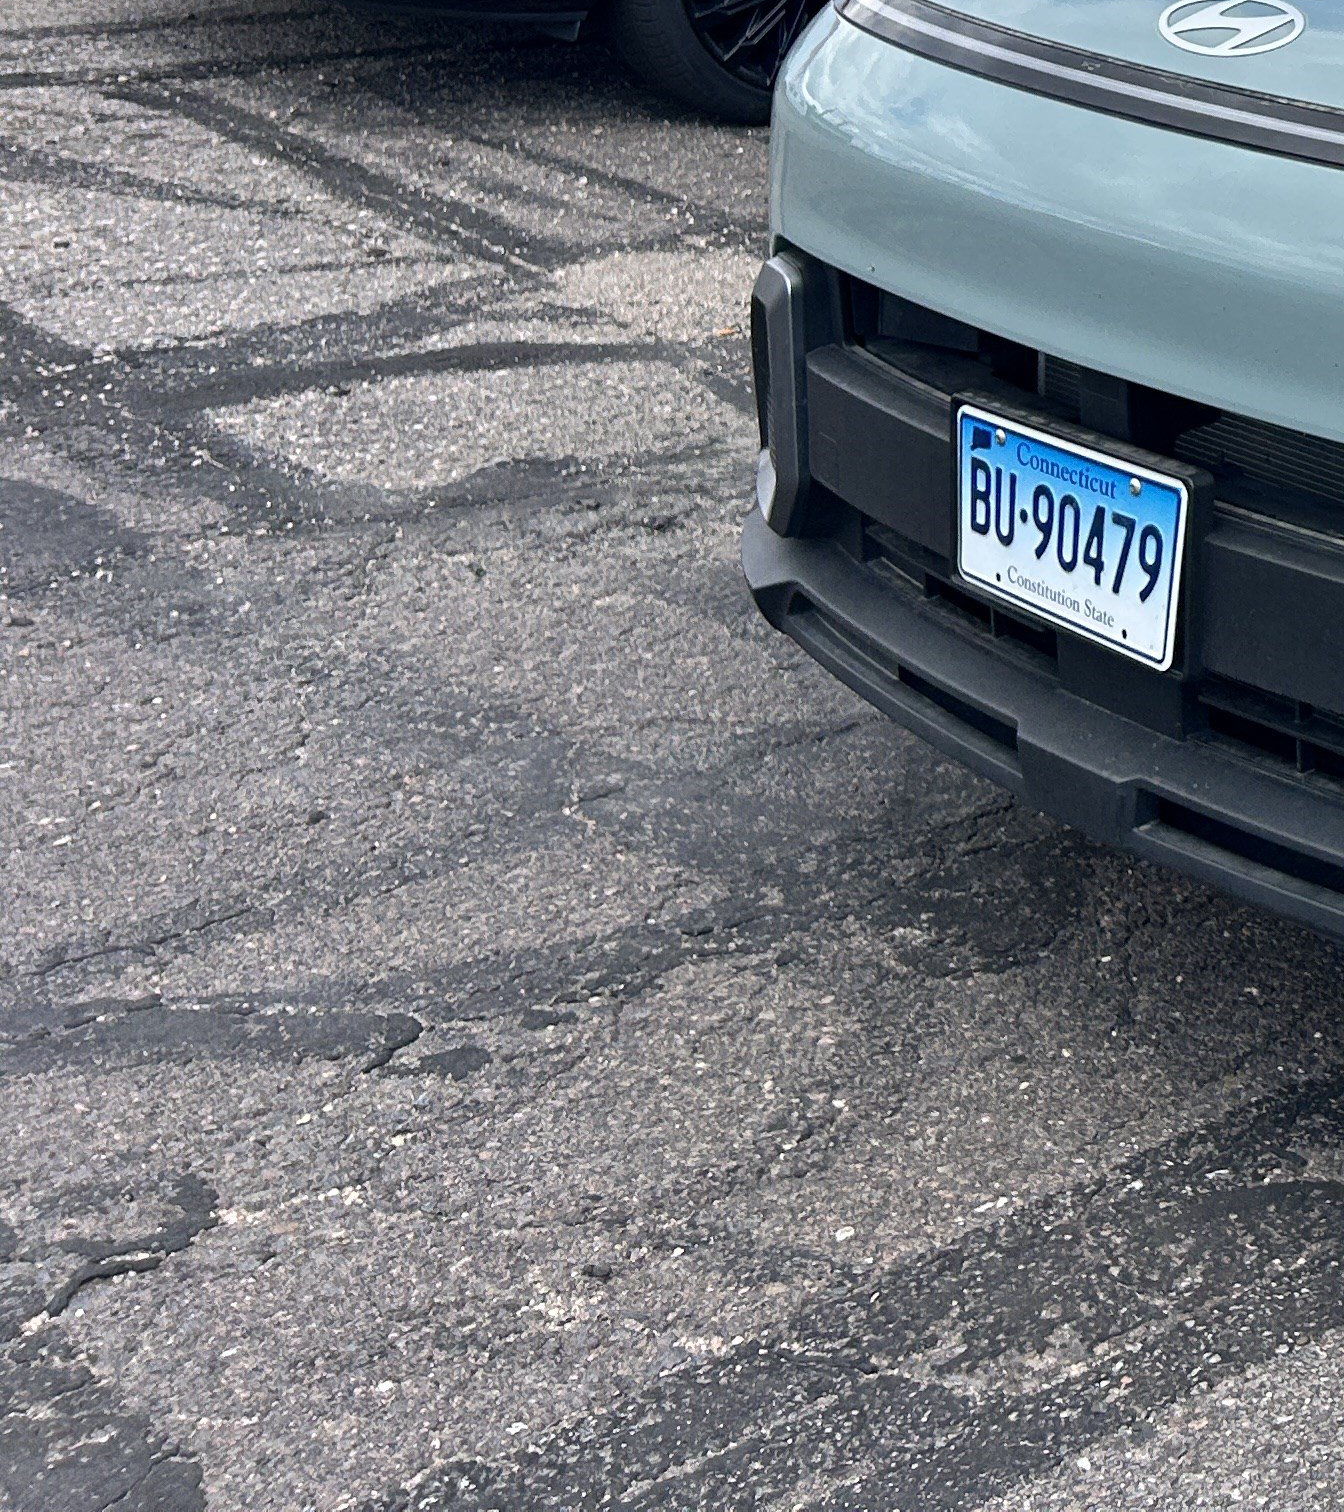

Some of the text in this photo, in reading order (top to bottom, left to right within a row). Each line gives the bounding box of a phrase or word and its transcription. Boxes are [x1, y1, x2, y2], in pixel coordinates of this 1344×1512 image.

[1016, 441, 1118, 500] Connecticut
[1007, 564, 1116, 629] Constitution State
